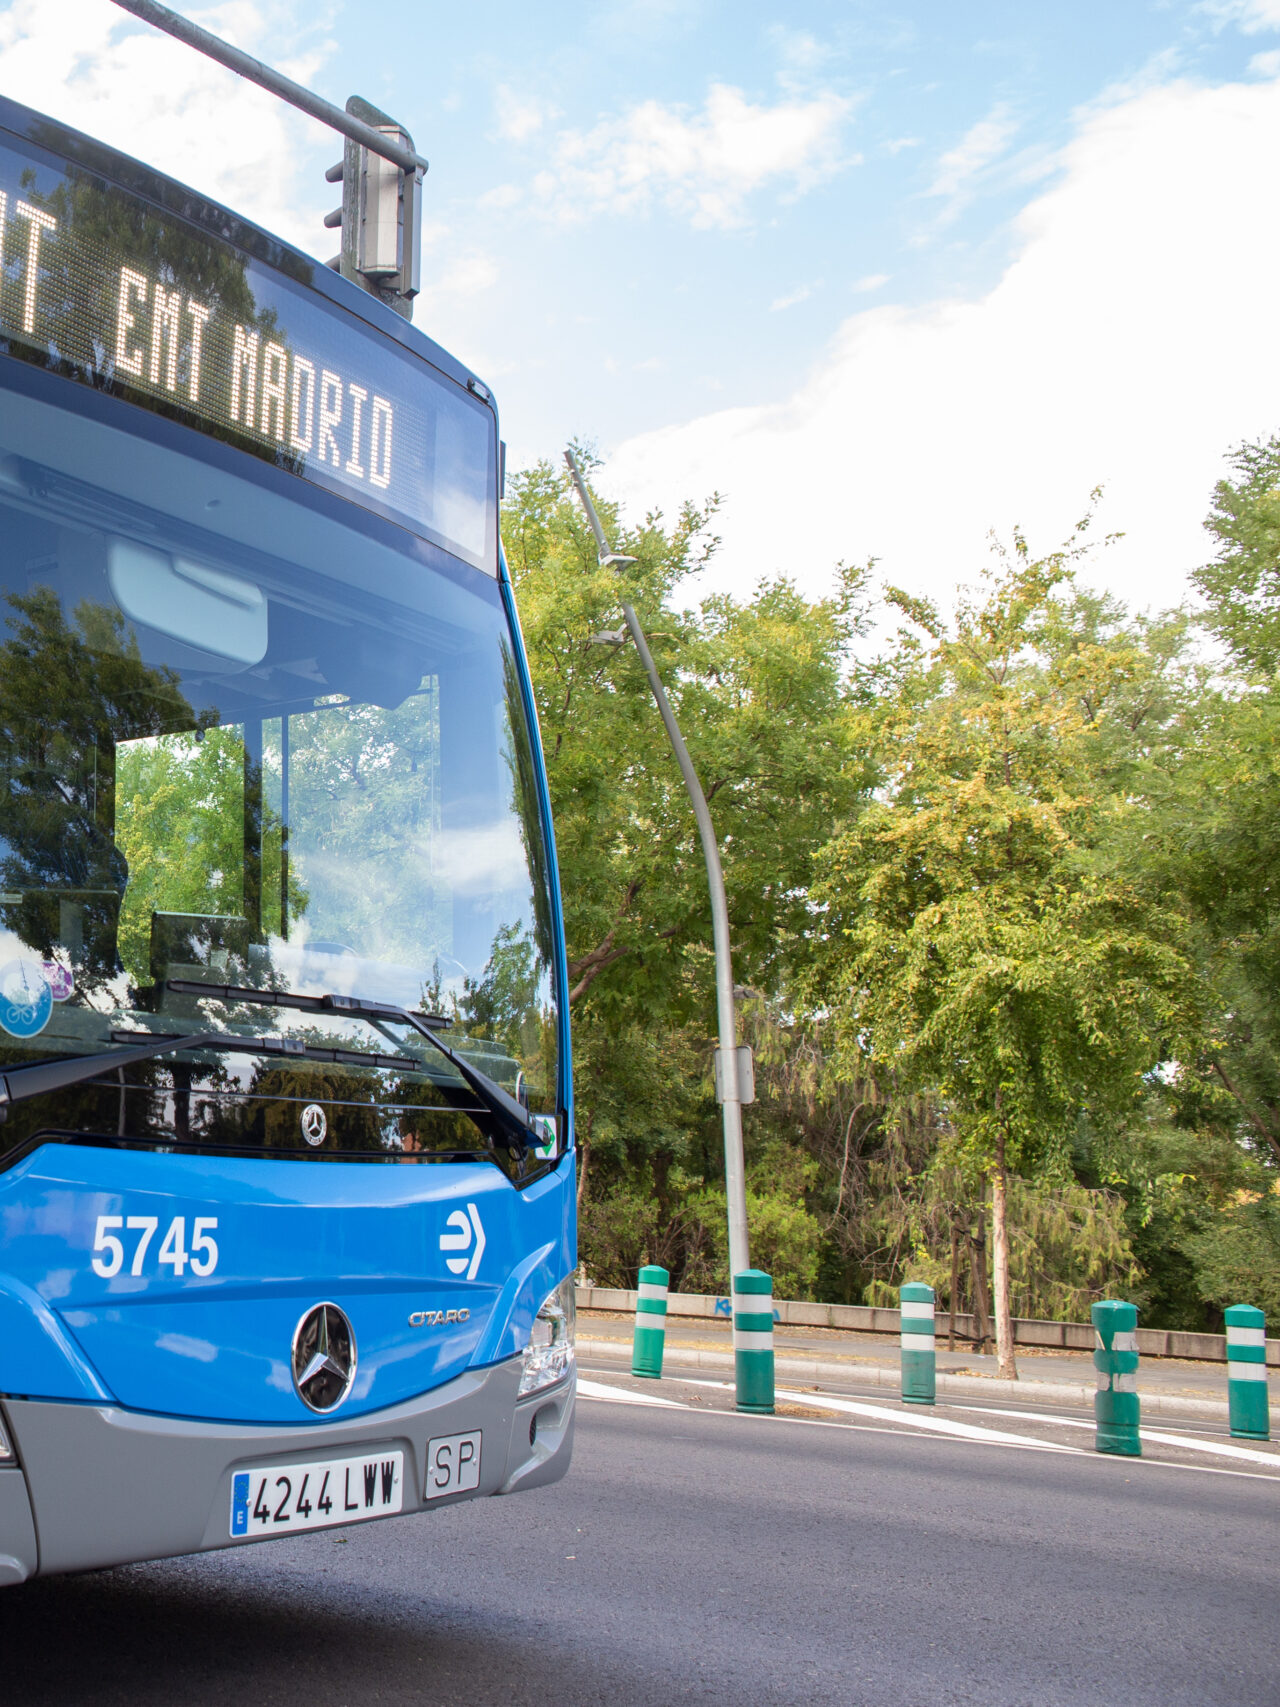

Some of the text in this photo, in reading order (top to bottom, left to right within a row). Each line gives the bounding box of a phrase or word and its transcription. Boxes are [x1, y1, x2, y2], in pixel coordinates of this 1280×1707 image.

[115, 266, 210, 402] EMT
[230, 323, 393, 489] MADRID
[91, 1215, 219, 1279] 5745
[408, 1308, 470, 1328] CITARO
[252, 1460, 395, 1524] 4244 LWW
[434, 1439, 475, 1489] SP
[236, 1510, 244, 1525] E
